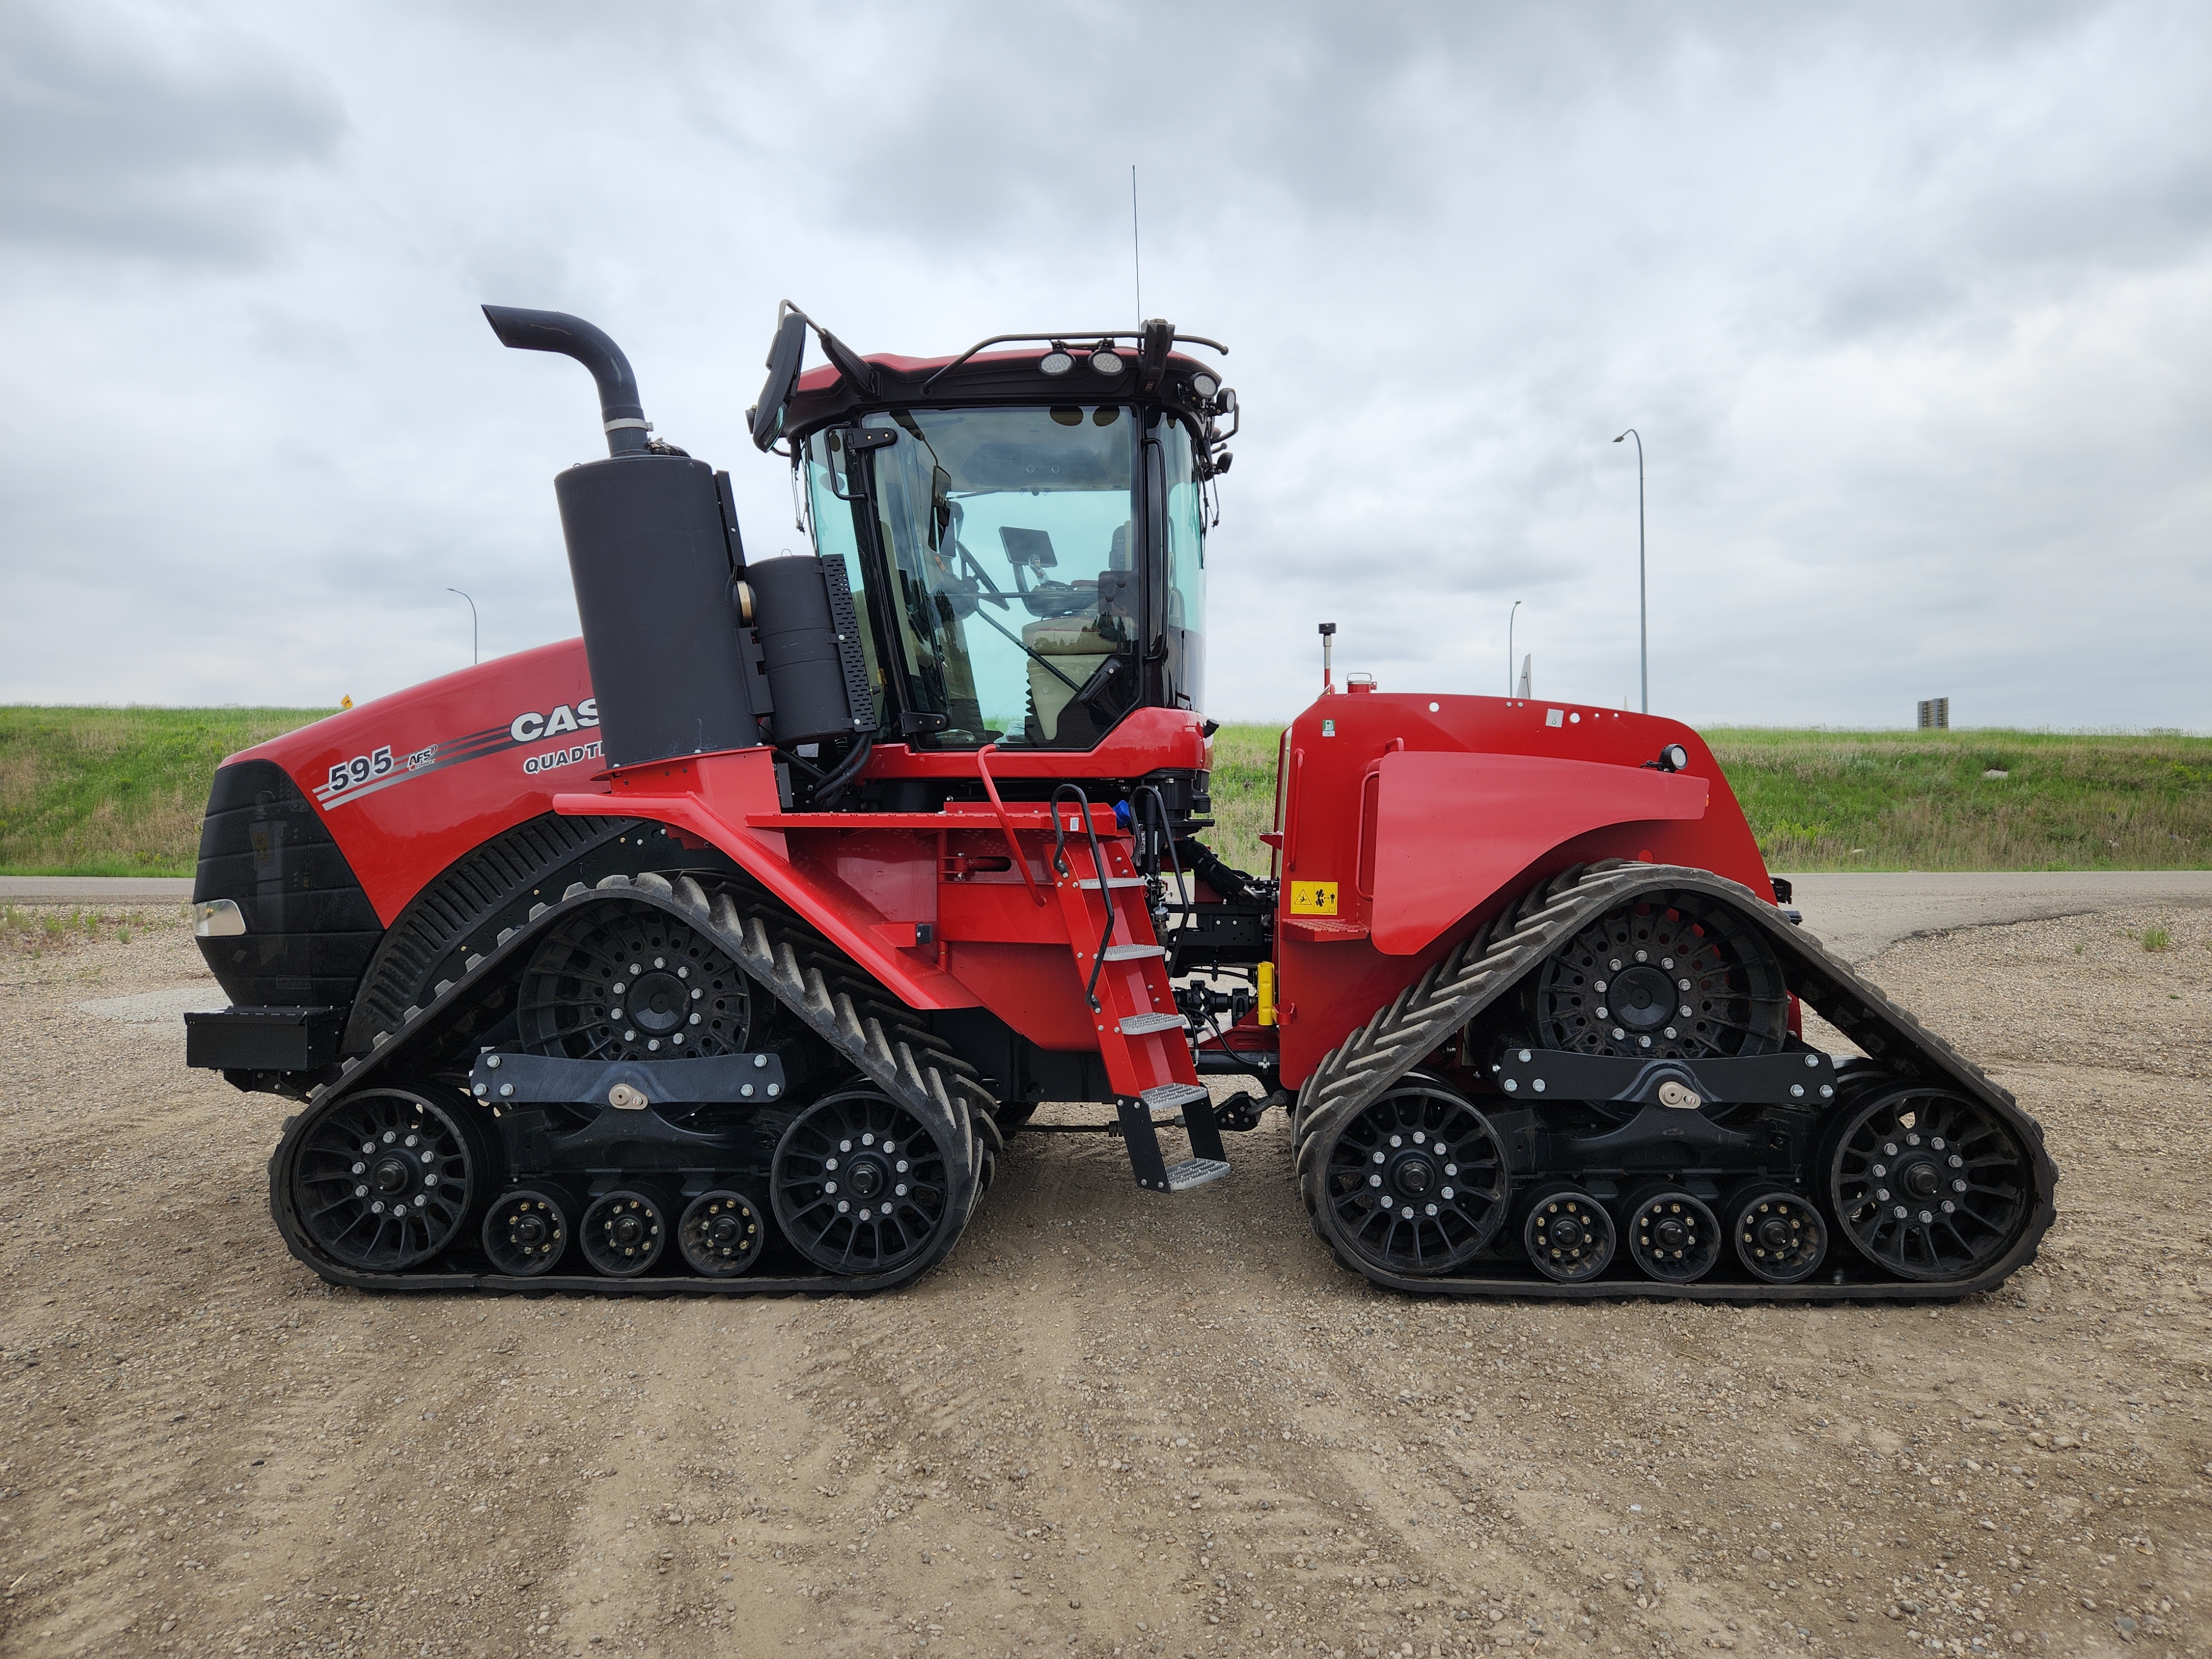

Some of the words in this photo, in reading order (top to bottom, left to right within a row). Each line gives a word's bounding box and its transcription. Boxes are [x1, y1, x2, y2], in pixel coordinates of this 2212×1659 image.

[328, 745, 394, 792] 595
[408, 749, 431, 767] AFS
[524, 740, 604, 774] QUADT
